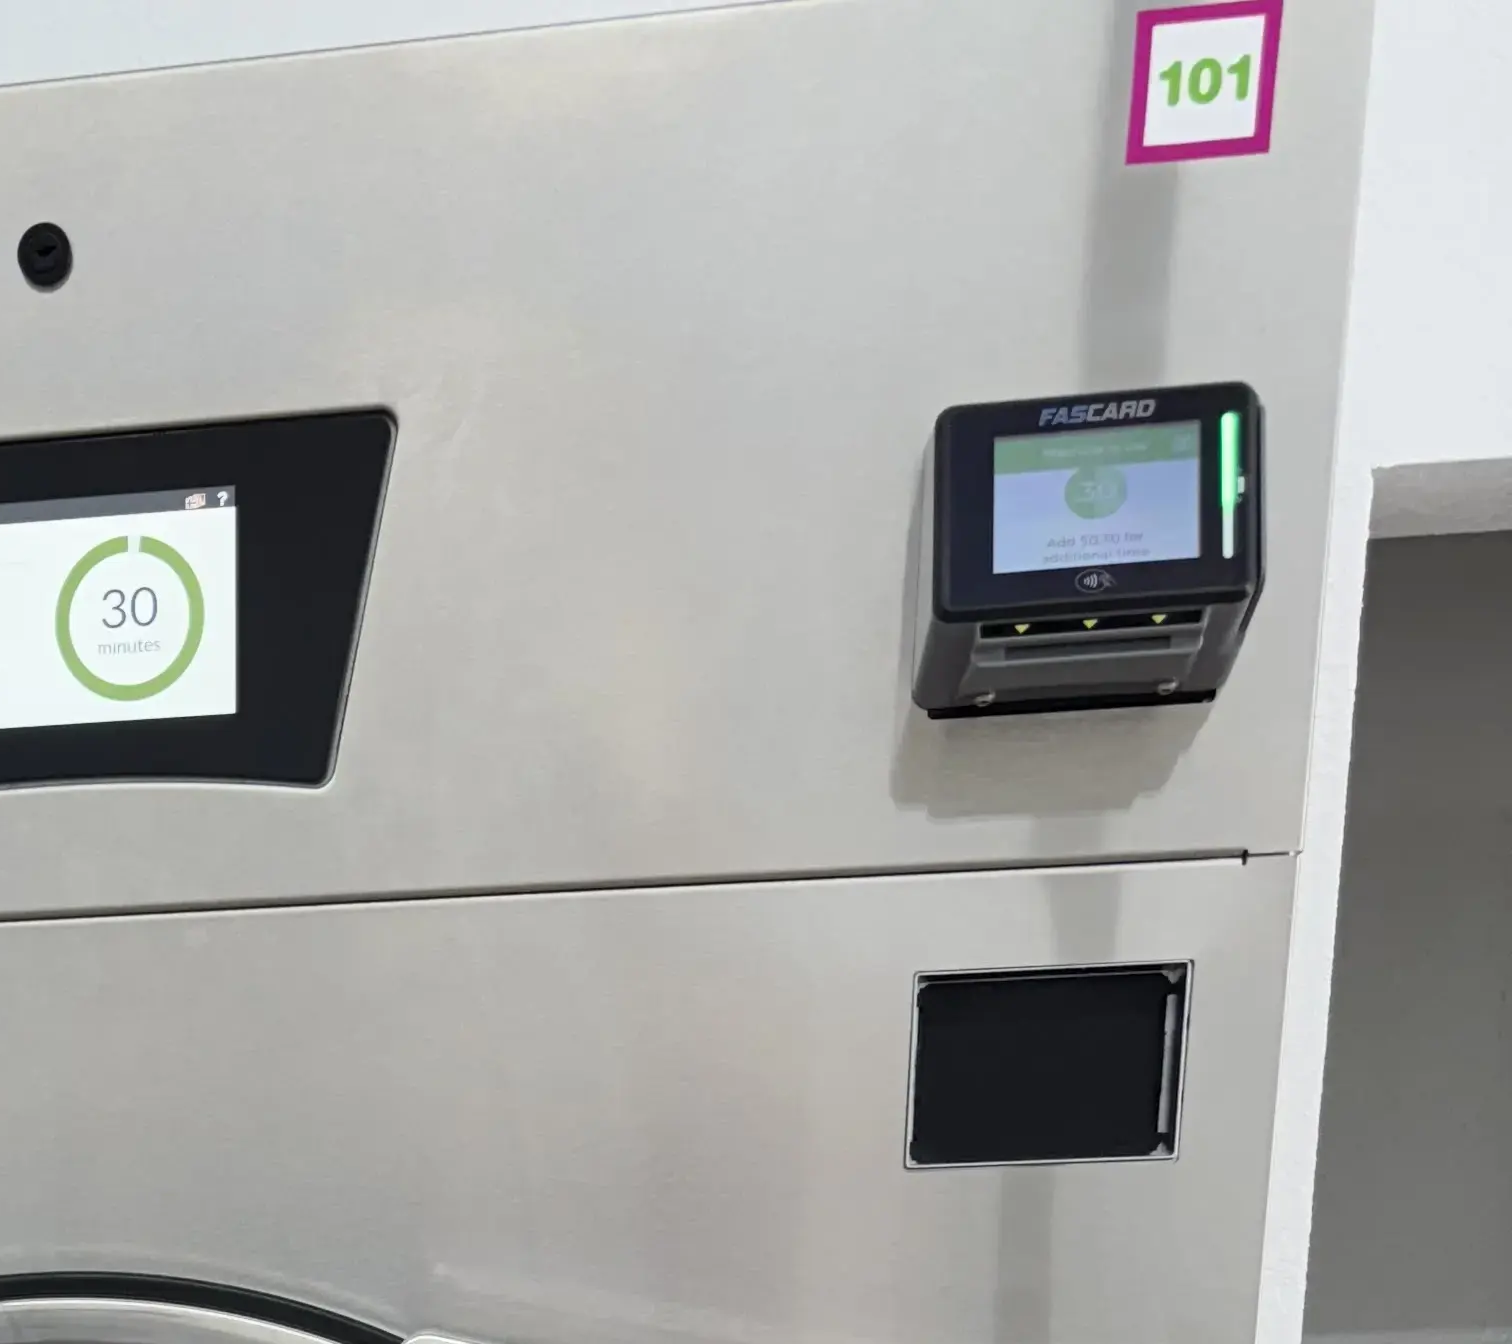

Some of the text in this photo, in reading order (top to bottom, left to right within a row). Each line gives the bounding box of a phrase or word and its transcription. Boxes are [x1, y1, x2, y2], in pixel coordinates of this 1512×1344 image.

[1159, 54, 1251, 107] 101
[1038, 399, 1156, 427] FASCARD
[101, 586, 159, 630] 30
[97, 637, 162, 656] minutes
